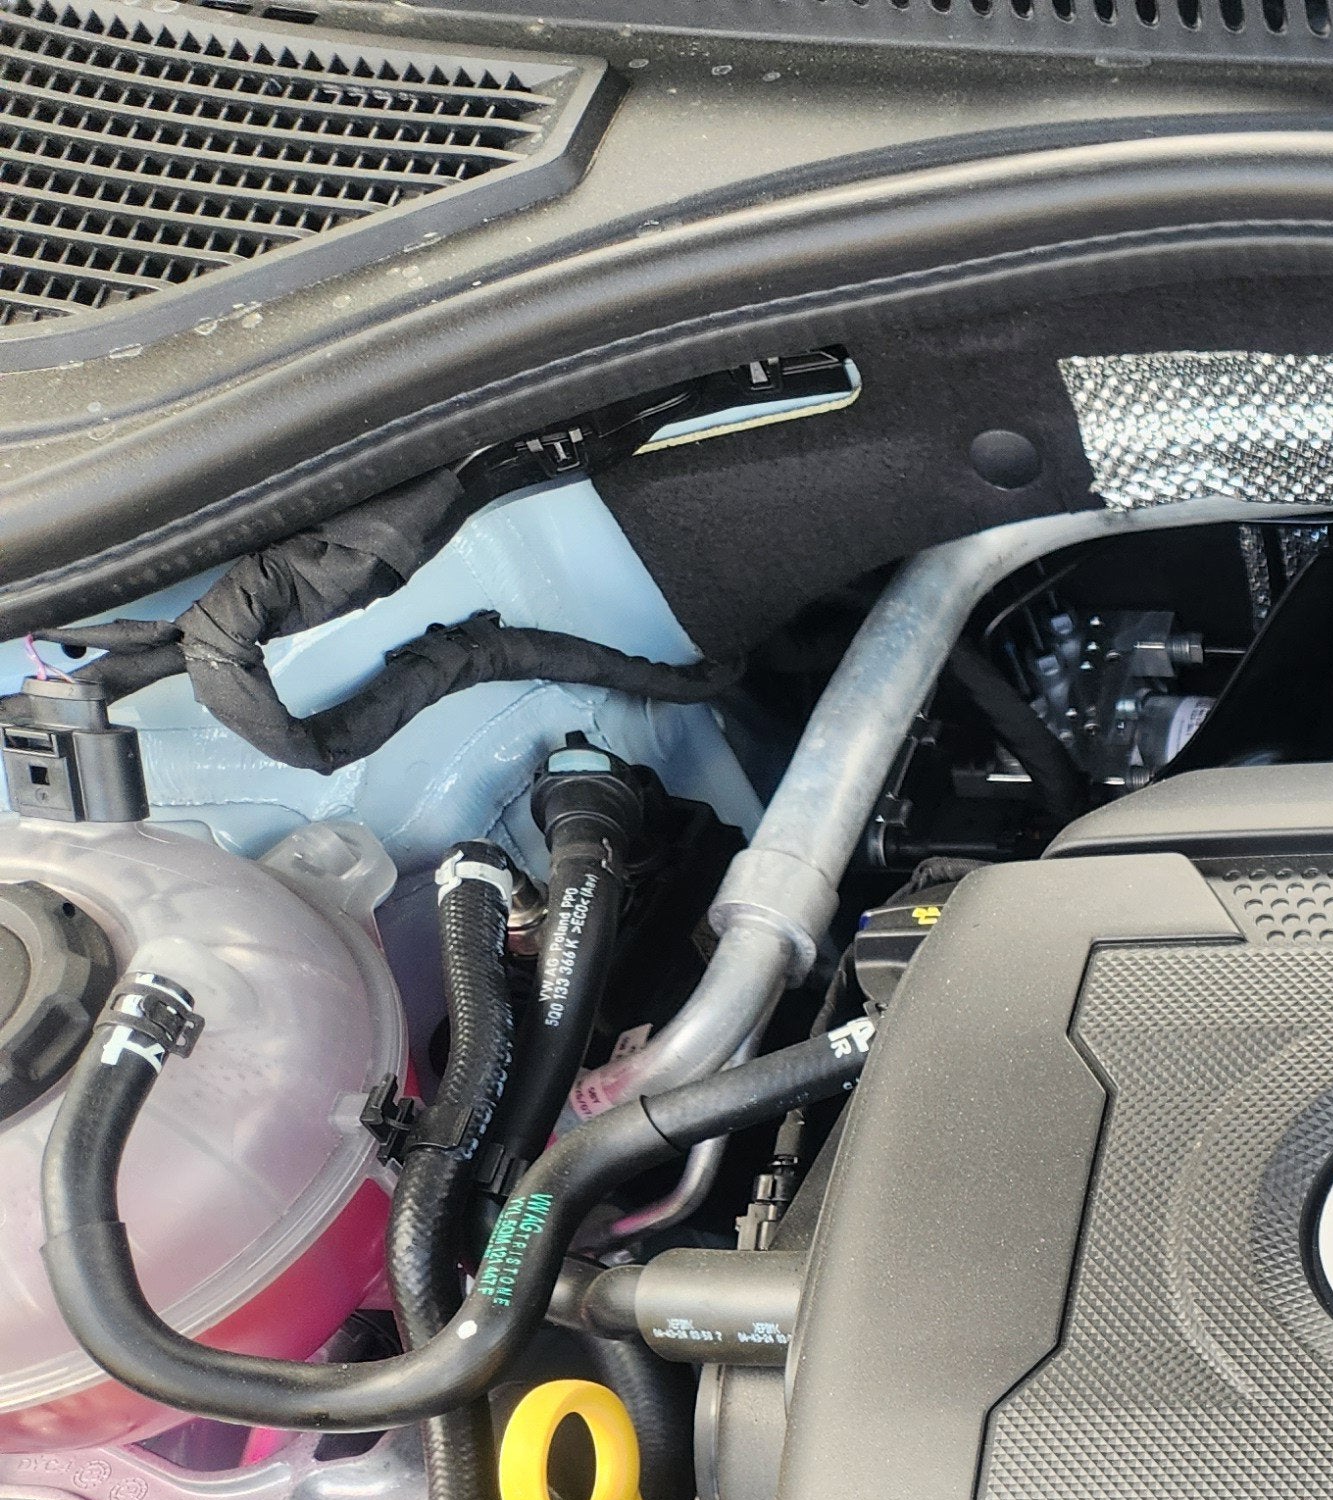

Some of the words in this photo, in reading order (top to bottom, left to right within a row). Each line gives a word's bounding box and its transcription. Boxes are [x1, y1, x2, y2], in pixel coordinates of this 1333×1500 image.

[549, 911, 571, 951] Poland
[564, 938, 579, 949] K
[544, 957, 559, 977] AG
[558, 949, 576, 975] 366
[538, 980, 554, 1003] VW
[552, 977, 570, 1000] 133
[525, 1190, 553, 1215] VW
[518, 1212, 546, 1235] AG
[487, 1244, 507, 1266] 121
